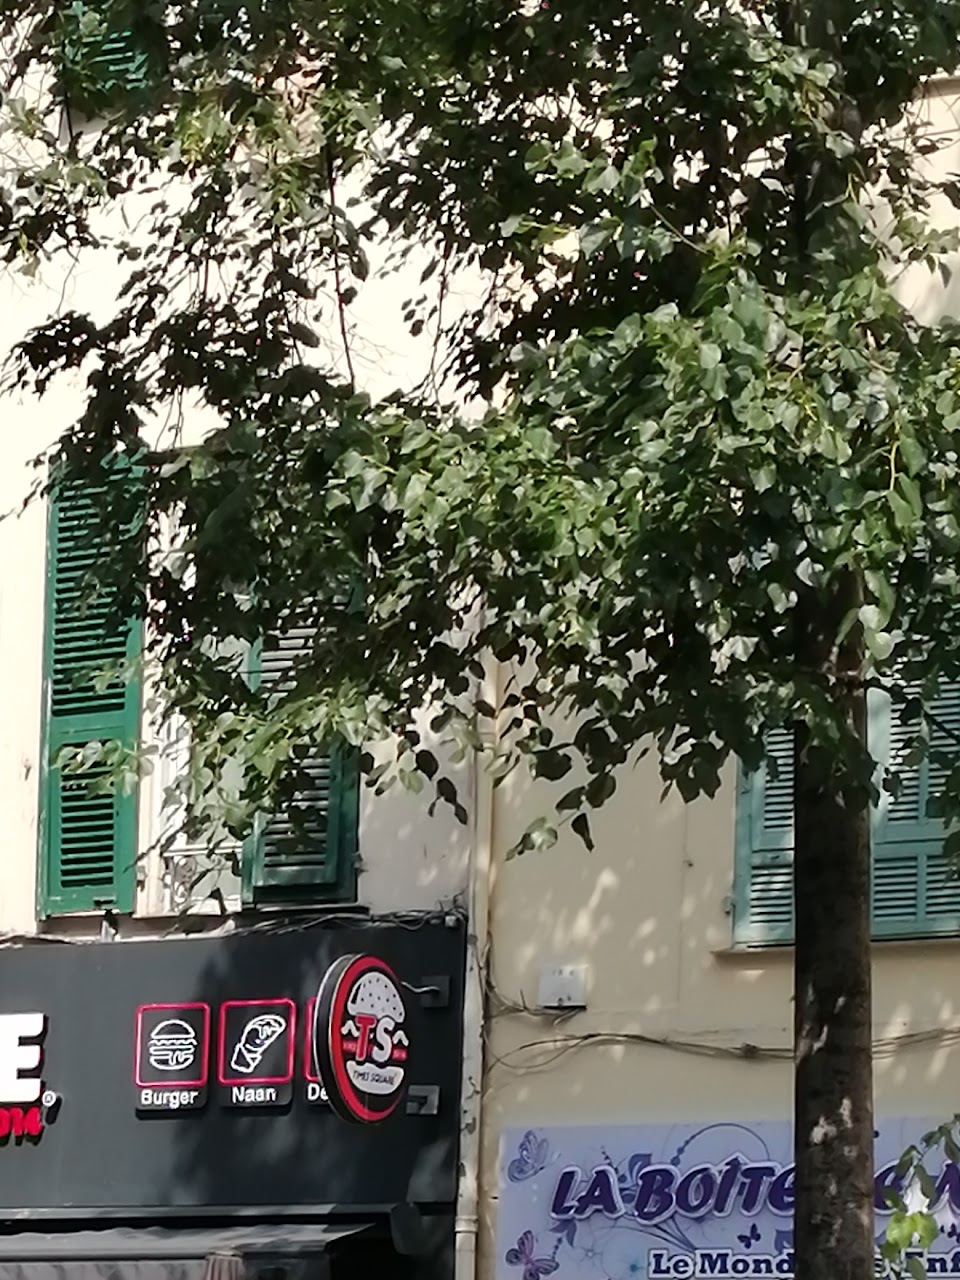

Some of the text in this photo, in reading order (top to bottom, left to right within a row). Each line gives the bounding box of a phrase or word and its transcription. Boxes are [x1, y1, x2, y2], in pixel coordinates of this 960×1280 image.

[141, 1088, 199, 1109] Burger
[231, 1086, 277, 1103] Naan
[551, 1168, 620, 1217] LA
[651, 1252, 692, 1275] Le
[699, 1252, 795, 1275] Mond
